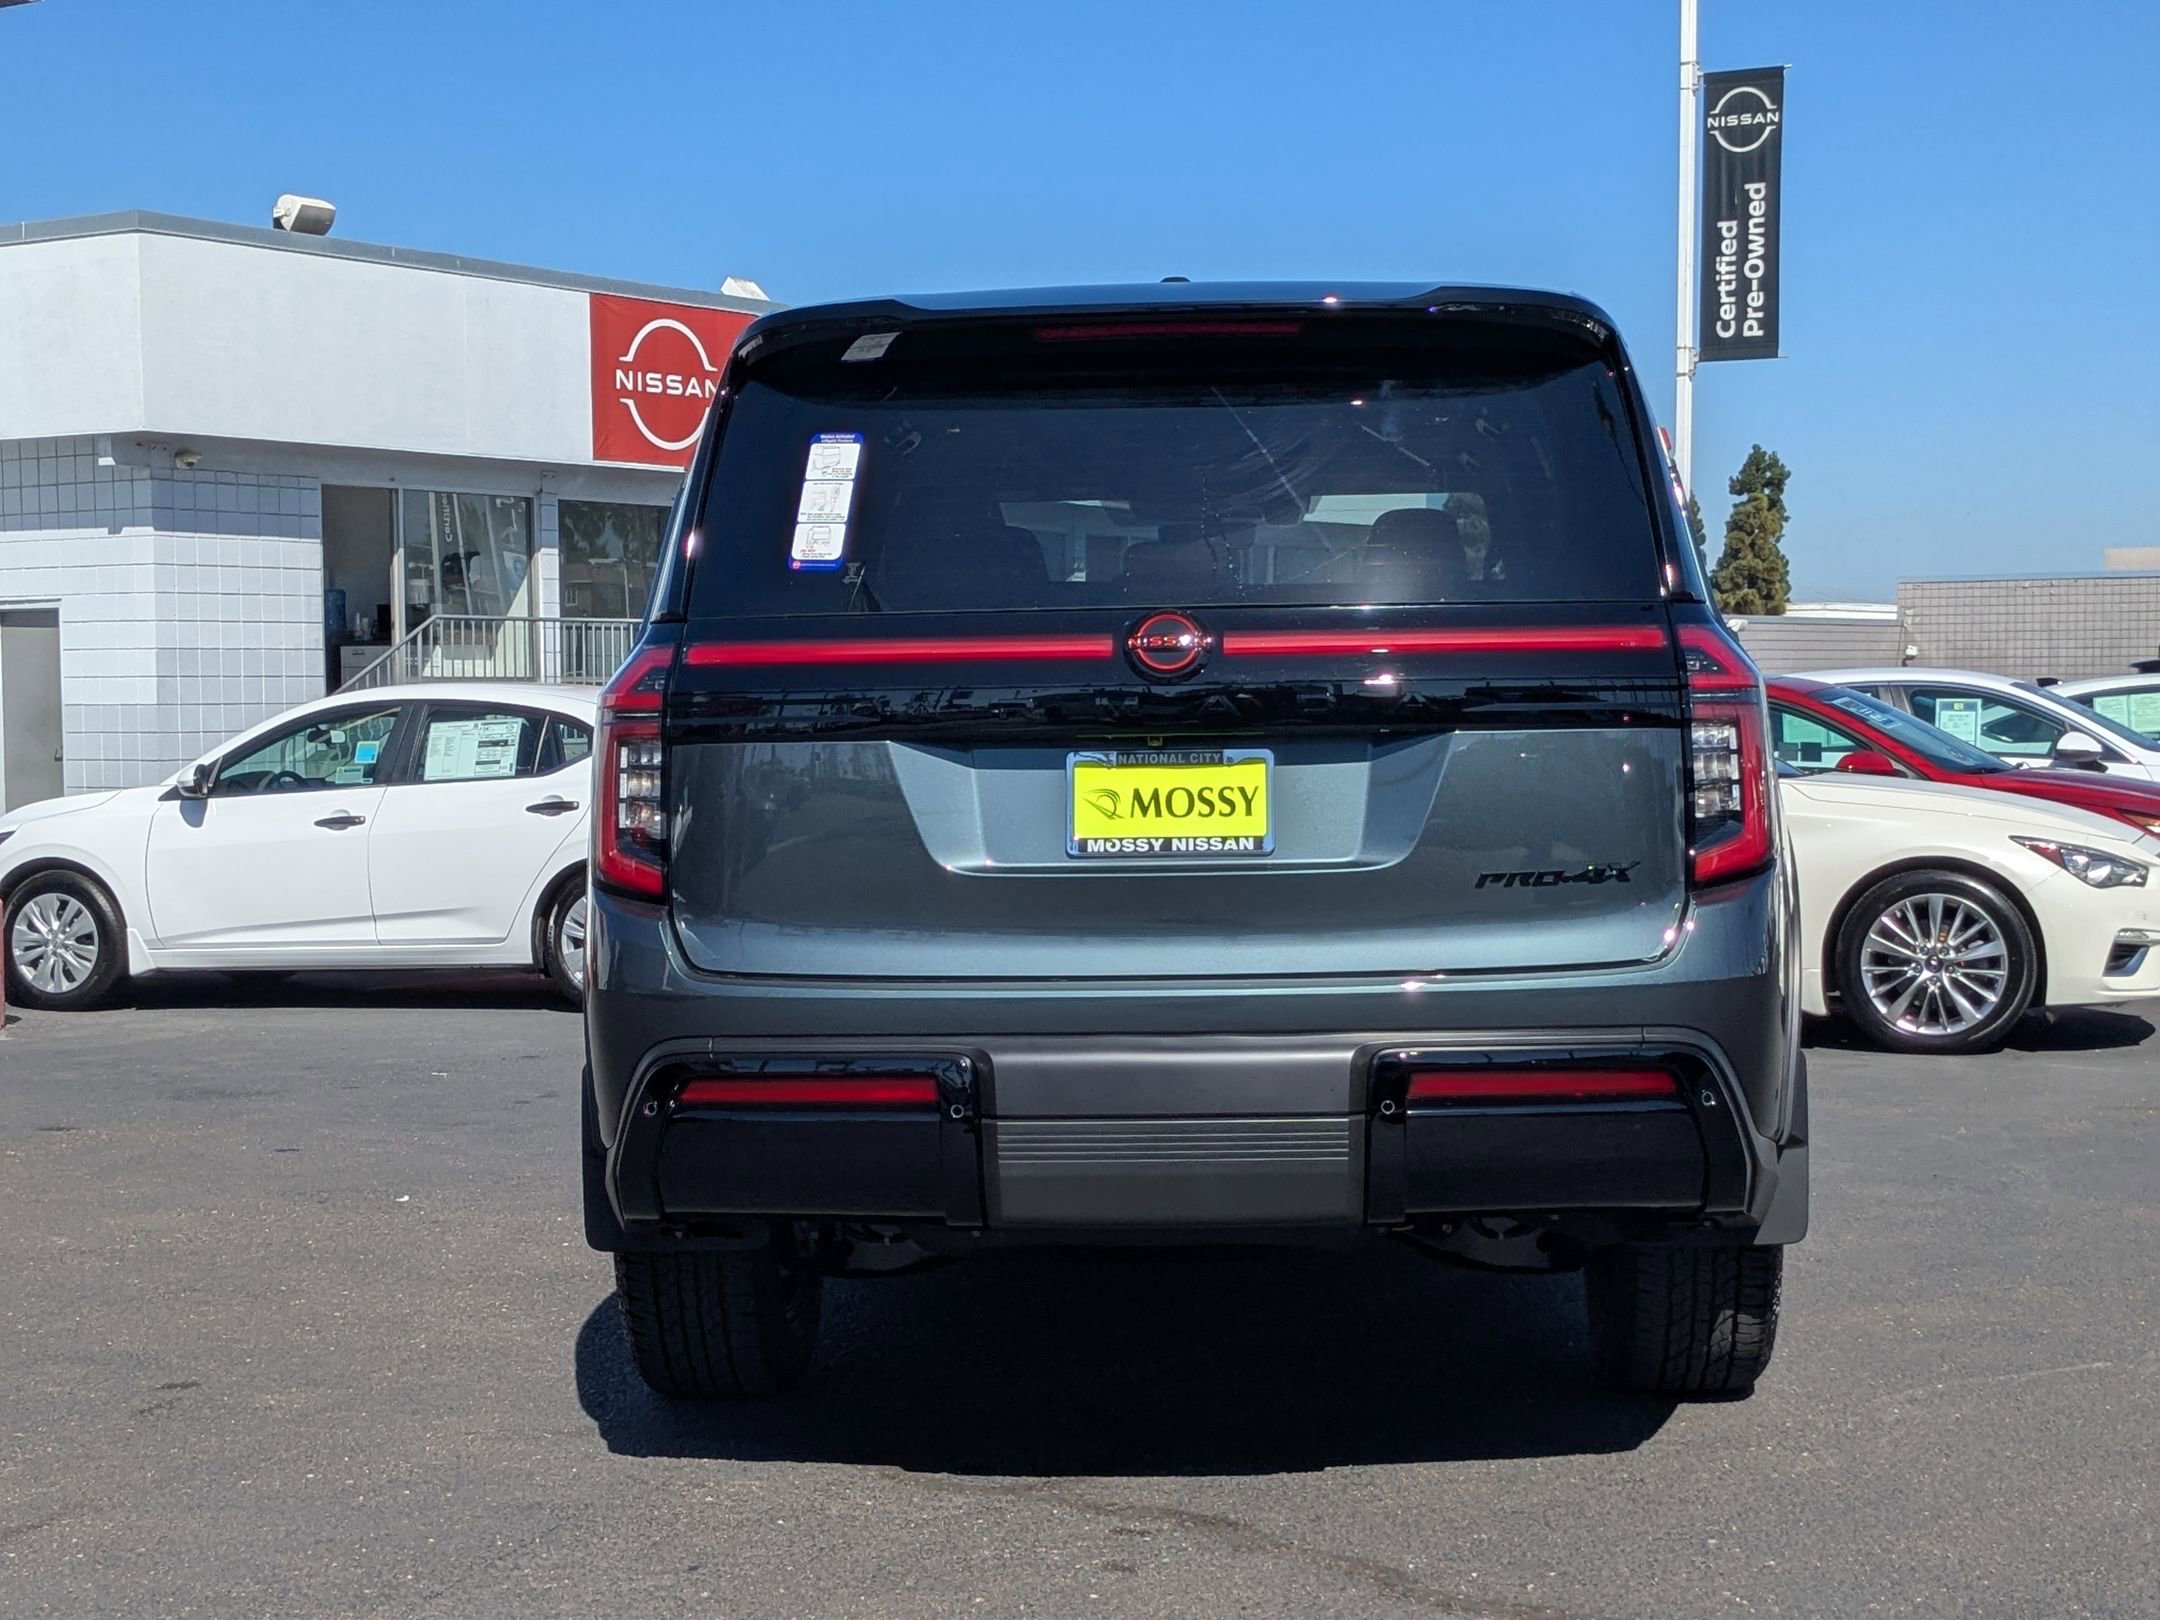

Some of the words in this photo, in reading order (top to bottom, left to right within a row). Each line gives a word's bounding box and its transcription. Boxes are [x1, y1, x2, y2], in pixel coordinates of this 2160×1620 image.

[1707, 111, 1779, 128] NISSAN
[1743, 181, 1767, 337] Pre-Owned
[1715, 219, 1738, 338] Certified
[615, 368, 718, 399] NISSAN
[1117, 754, 1185, 767] NATIONAL
[1189, 753, 1222, 764] CITY
[1130, 786, 1260, 819] MOSSY
[1087, 838, 1164, 852] MOSSY
[1172, 837, 1255, 851] NISSAN
